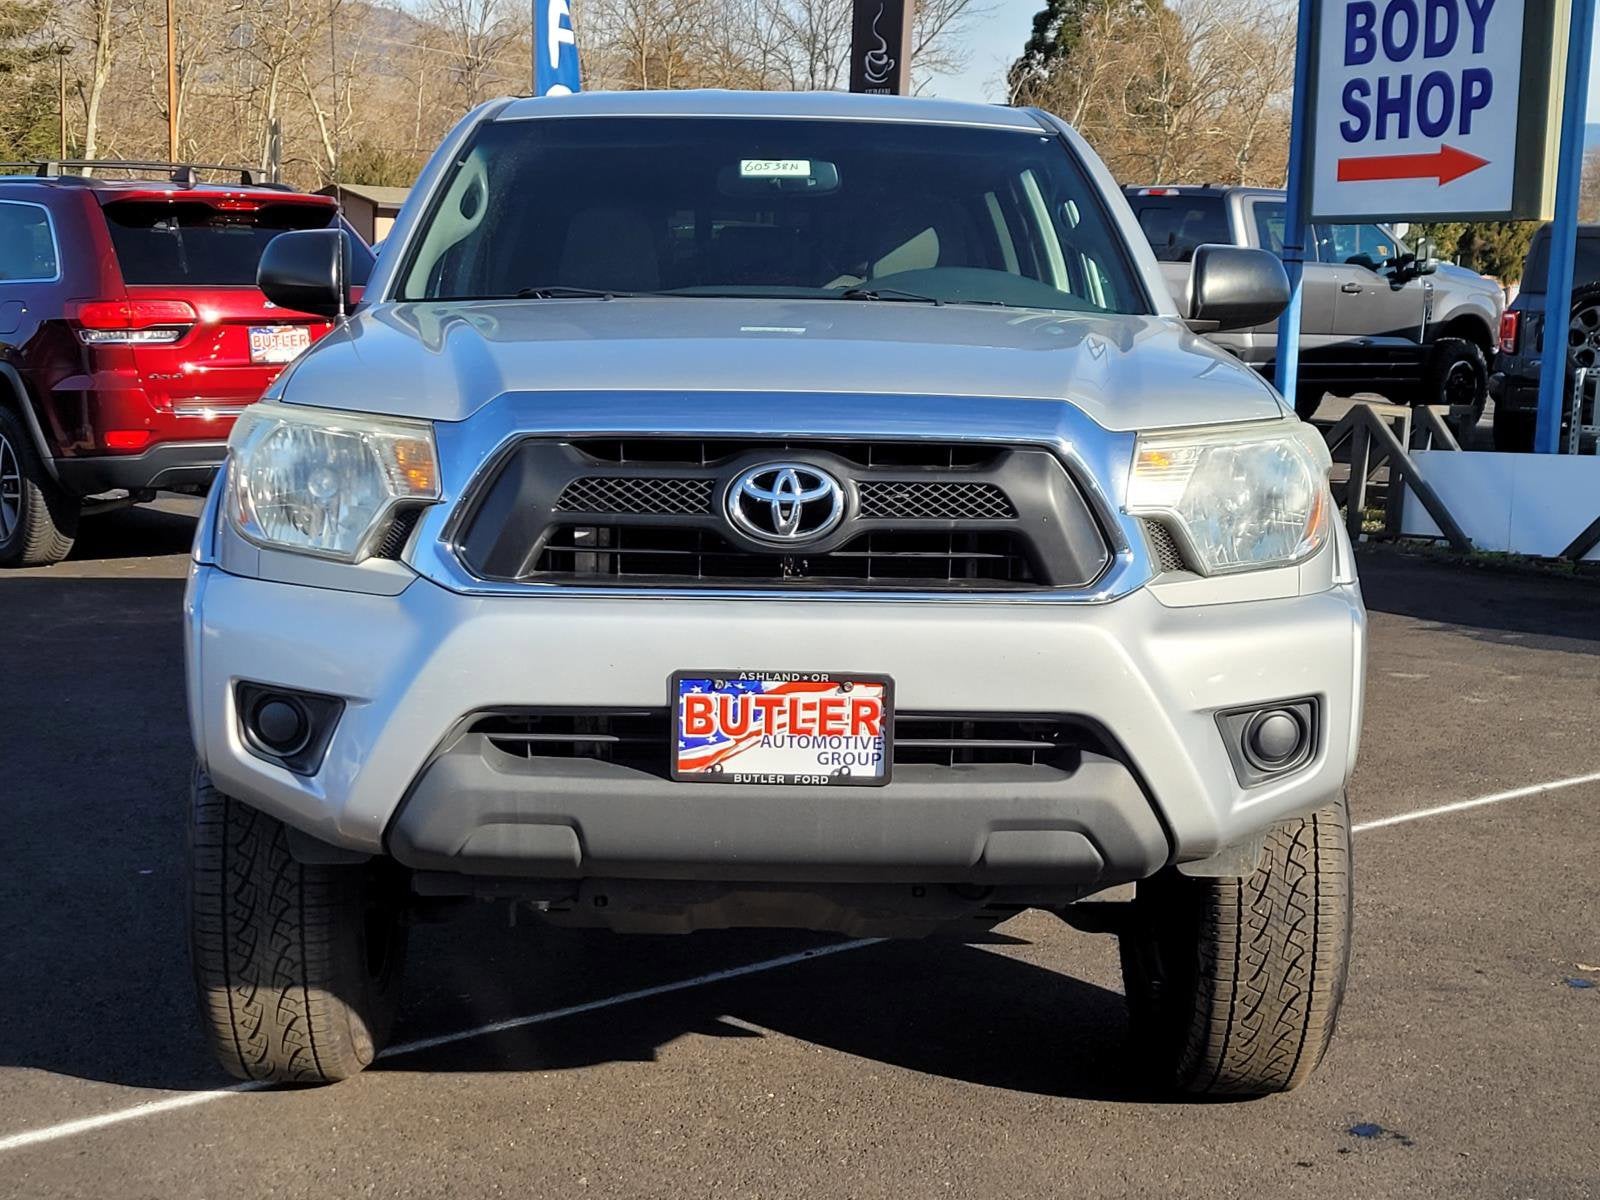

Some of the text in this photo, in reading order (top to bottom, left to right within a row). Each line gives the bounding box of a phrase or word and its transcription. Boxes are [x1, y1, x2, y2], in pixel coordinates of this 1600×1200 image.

[1344, 0, 1496, 66] BODY
[1339, 67, 1493, 143] SHOP
[253, 334, 307, 348] BUTLER
[738, 672, 829, 683] ASHLAND OR
[685, 694, 882, 737] BUTLER
[760, 735, 882, 751] AUTOMOTIVE
[817, 751, 882, 766] GROUP
[733, 774, 829, 785] BUTLER FORD
